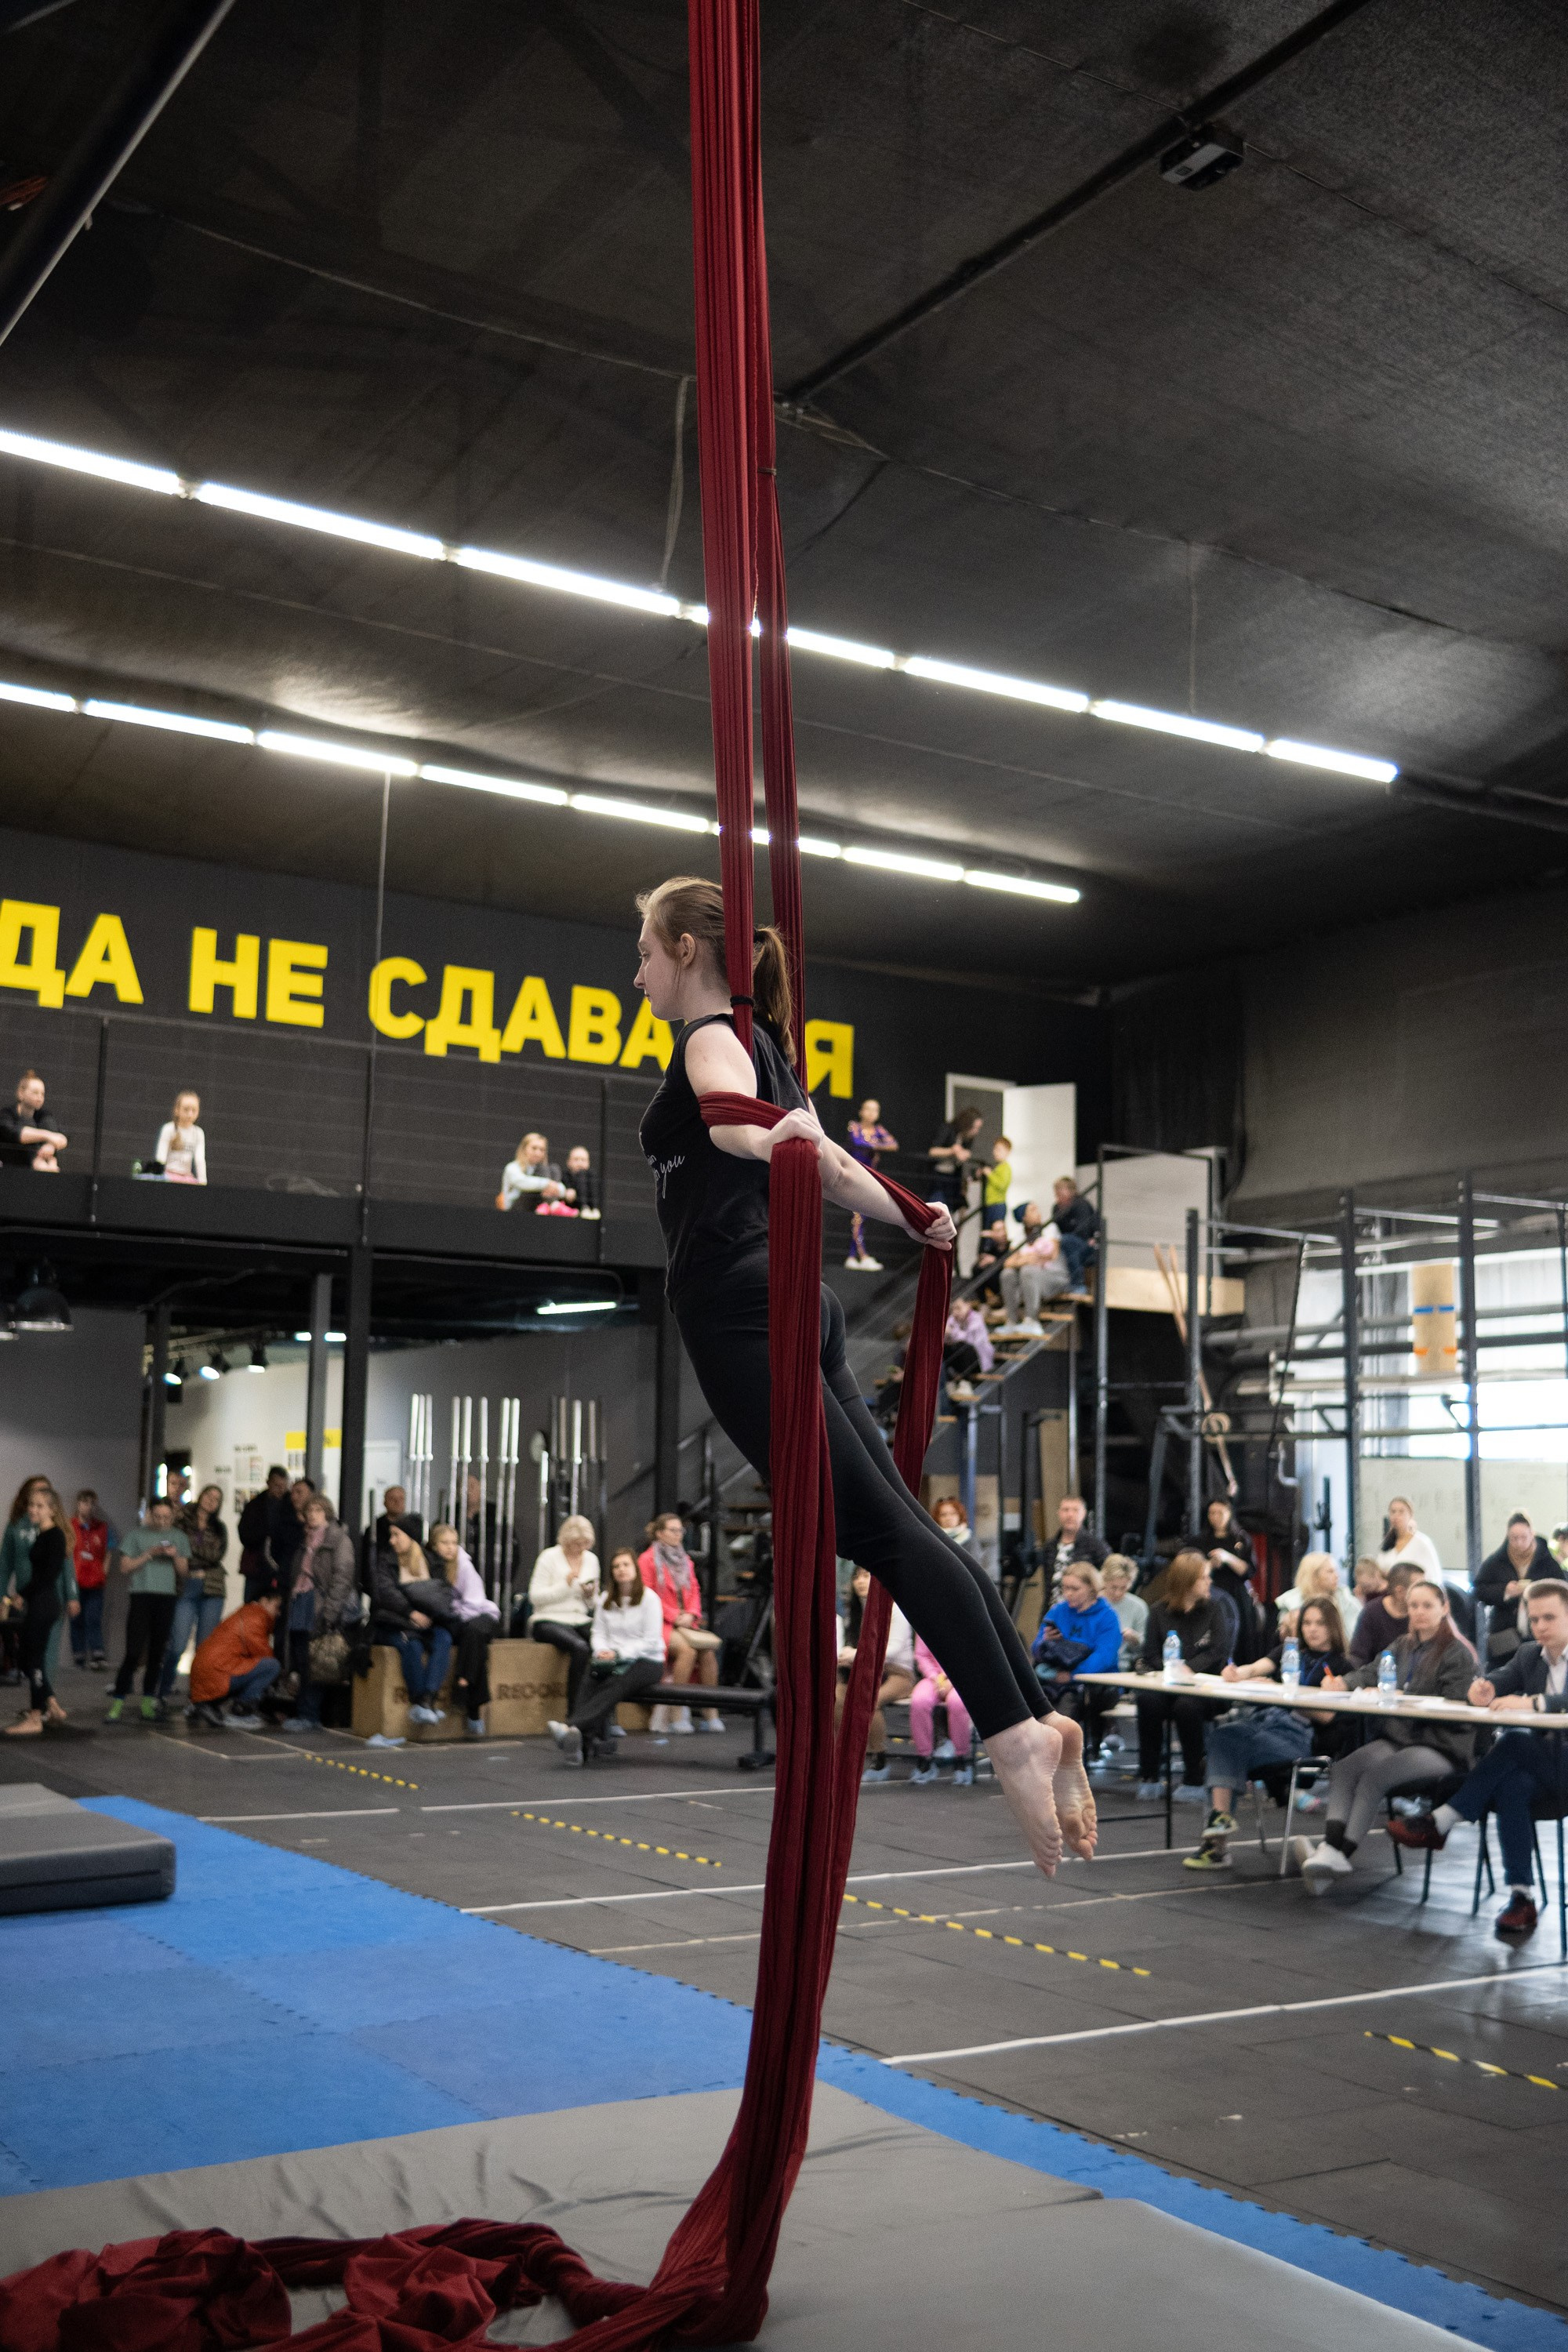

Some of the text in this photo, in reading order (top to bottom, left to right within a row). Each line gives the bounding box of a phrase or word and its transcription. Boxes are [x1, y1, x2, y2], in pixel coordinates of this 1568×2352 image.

[0, 898, 854, 1098] ДА НЕ СДАВАЯ
[660, 1155, 685, 1199] you
